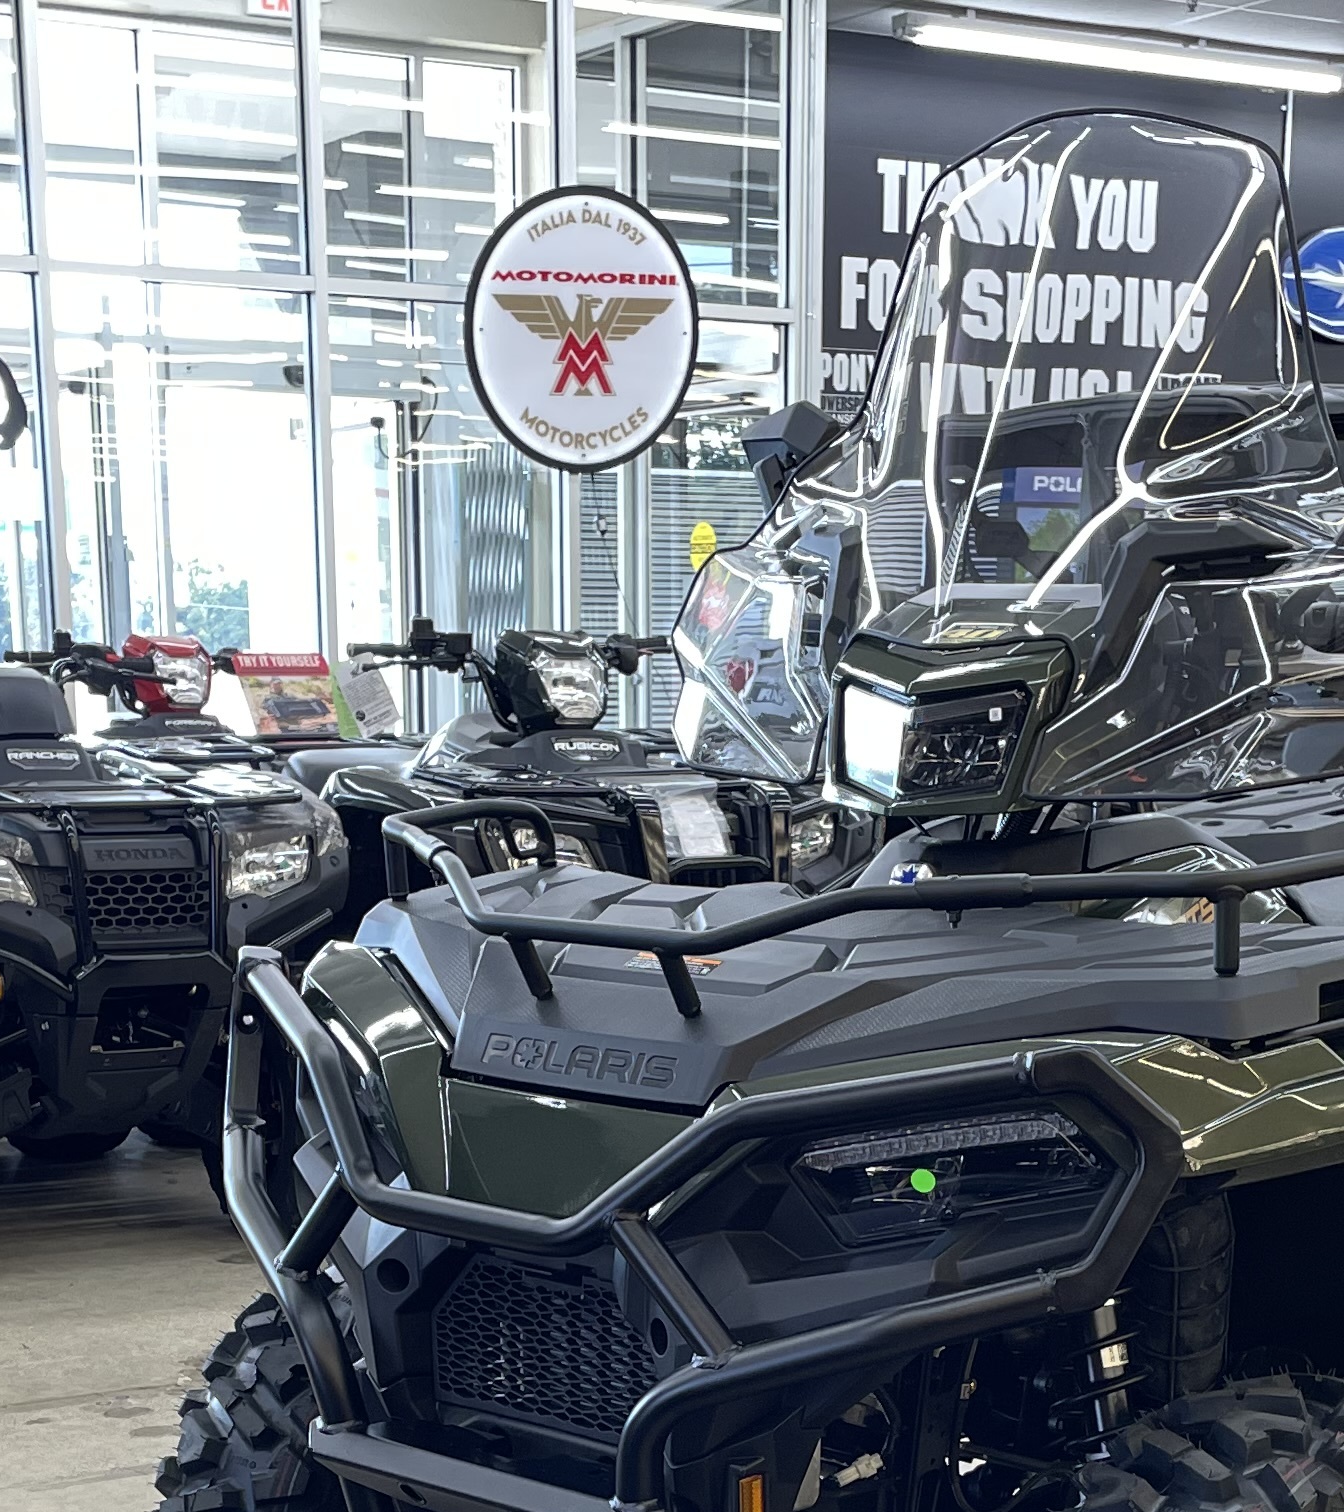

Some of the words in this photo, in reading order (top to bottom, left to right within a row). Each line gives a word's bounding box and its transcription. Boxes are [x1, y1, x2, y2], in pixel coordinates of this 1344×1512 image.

[877, 157, 1056, 250] THANK
[1070, 174, 1159, 253] YOU
[527, 210, 576, 242] ITALIA
[582, 208, 612, 229] DAL
[616, 218, 647, 246] 1937
[491, 270, 678, 286] MOTOMORINI
[840, 256, 948, 338] FOR
[961, 268, 1210, 353] SHOPPING
[519, 406, 649, 450] MOTORCYCLES
[237, 655, 257, 668] TRY
[258, 655, 269, 668] IT
[270, 655, 321, 668] YOURSELF
[6, 751, 80, 761] RANCHER
[554, 741, 621, 753] RUBICON
[94, 847, 188, 862] HONDA
[480, 1032, 680, 1090] POLARIS
